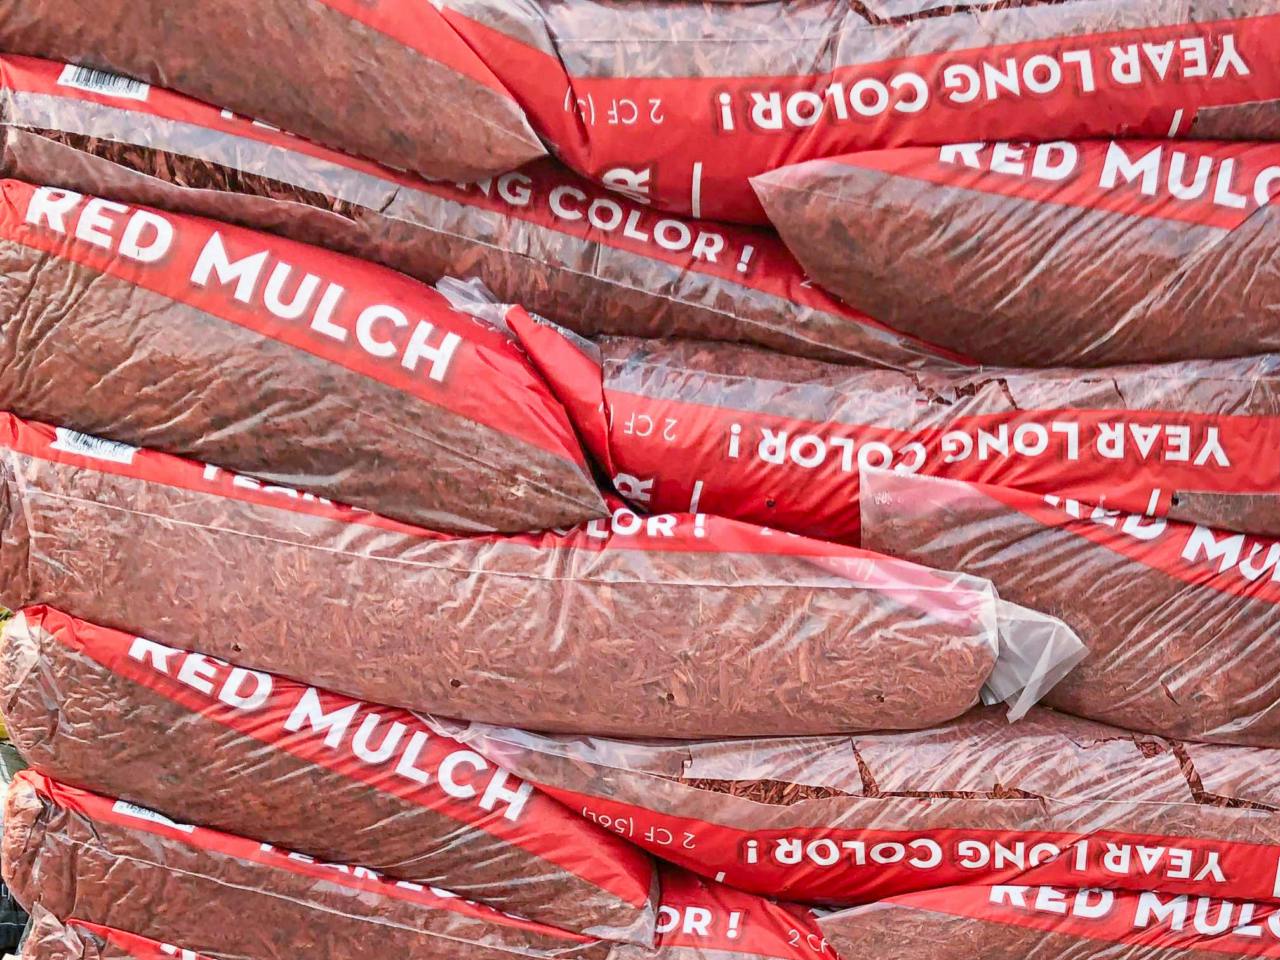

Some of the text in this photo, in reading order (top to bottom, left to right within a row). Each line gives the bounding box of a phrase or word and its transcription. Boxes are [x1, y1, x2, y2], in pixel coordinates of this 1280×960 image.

[1110, 34, 1250, 84] YEAR
[943, 50, 1094, 103] LONG
[608, 99, 638, 125] CF
[648, 98, 664, 124] 2
[25, 186, 463, 383] RED MULCH
[623, 411, 654, 436] CF
[663, 418, 678, 441] 2
[941, 421, 1079, 463] LONG
[1096, 422, 1231, 467] YEAR
[127, 637, 535, 822] RED MULCH
[644, 825, 674, 846] CF
[683, 832, 696, 849] 2
[1104, 842, 1228, 882] YEAR
[787, 928, 801, 946] 2
